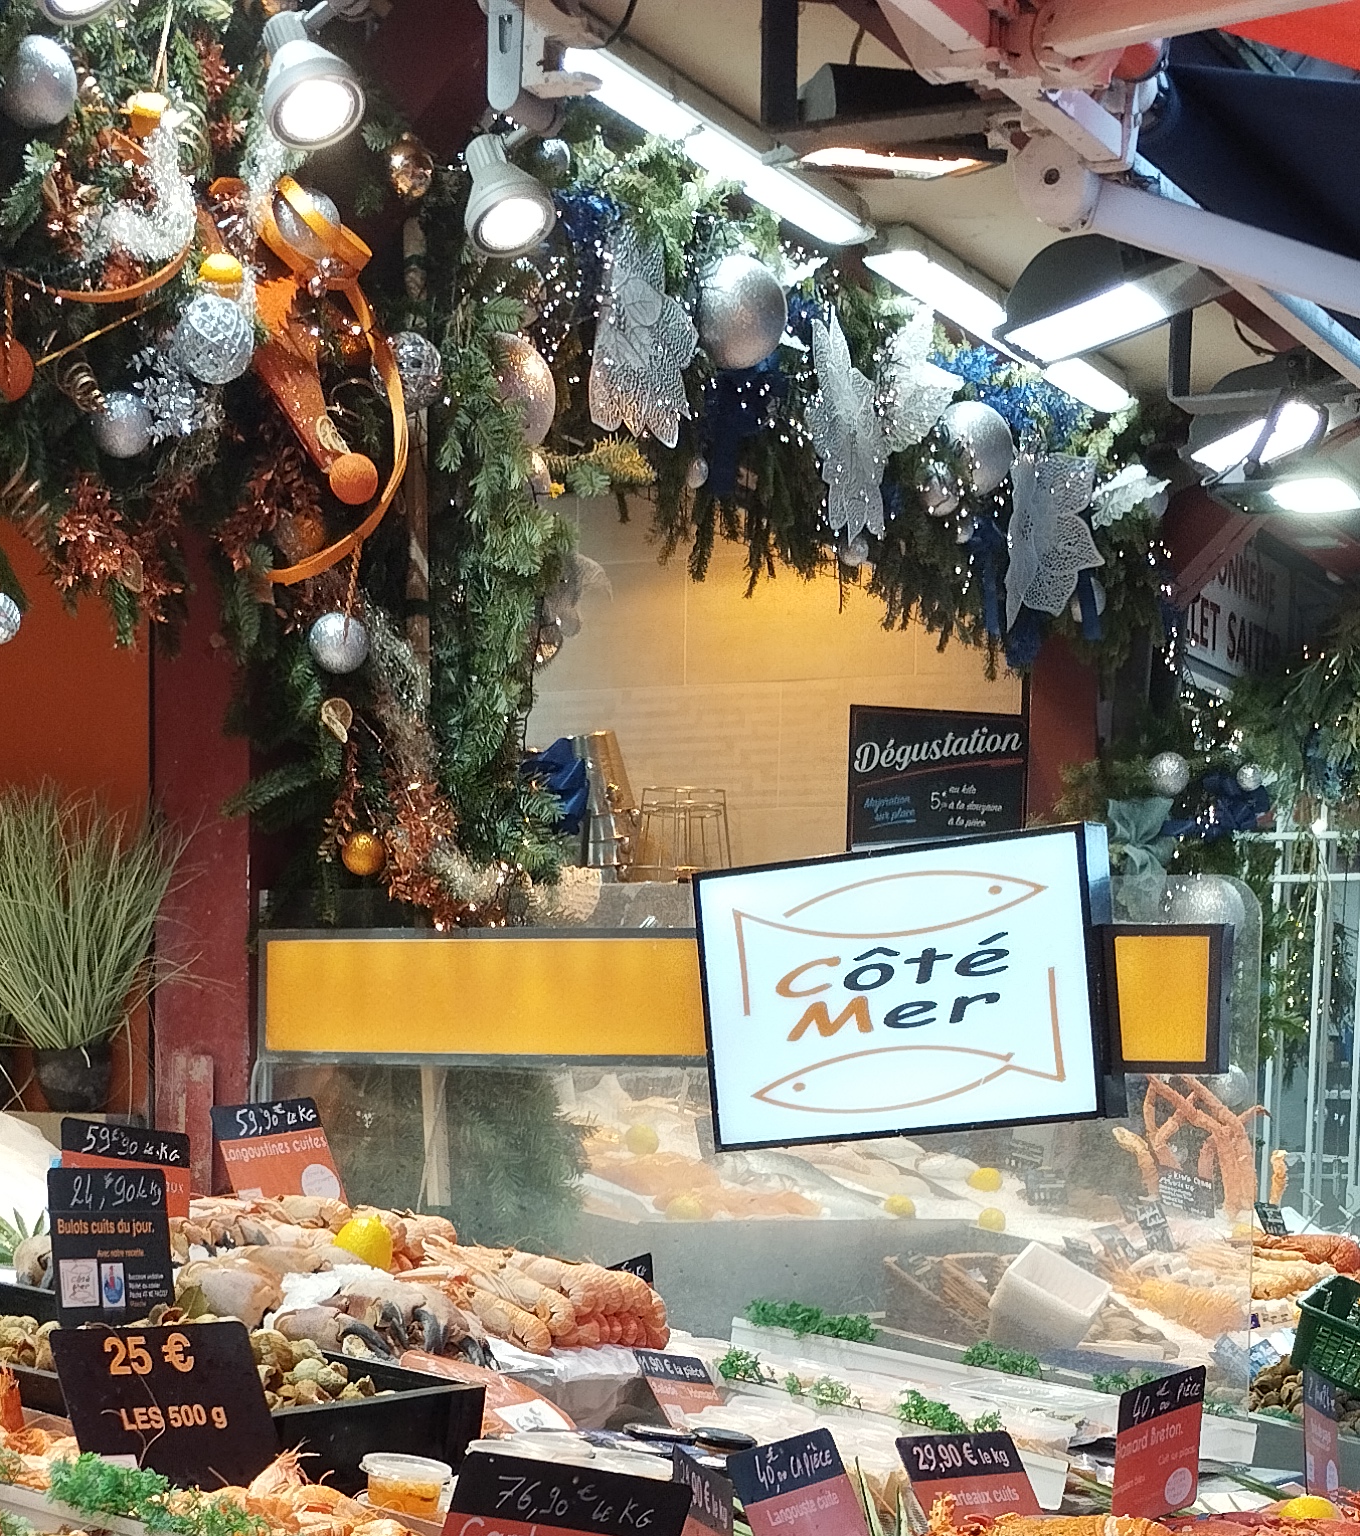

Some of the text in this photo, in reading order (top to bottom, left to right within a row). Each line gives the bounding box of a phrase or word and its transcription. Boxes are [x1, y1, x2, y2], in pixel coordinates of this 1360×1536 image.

[853, 726, 1024, 773] Dégustation
[775, 931, 1010, 999] Côté
[787, 992, 1002, 1042] Mer
[223, 1134, 328, 1164] Langoustines cuites
[57, 1217, 90, 1236] Bulots
[91, 1219, 115, 1235] cuits
[117, 1219, 131, 1234] du
[104, 1332, 195, 1376] 25 €
[119, 1403, 228, 1432] LES 500 g
[913, 1441, 1010, 1475] 29,90 € le kg
[767, 1490, 841, 1528] Langouste cuite
[993, 1484, 1020, 1504] cuits
[618, 1501, 655, 1529] KG
